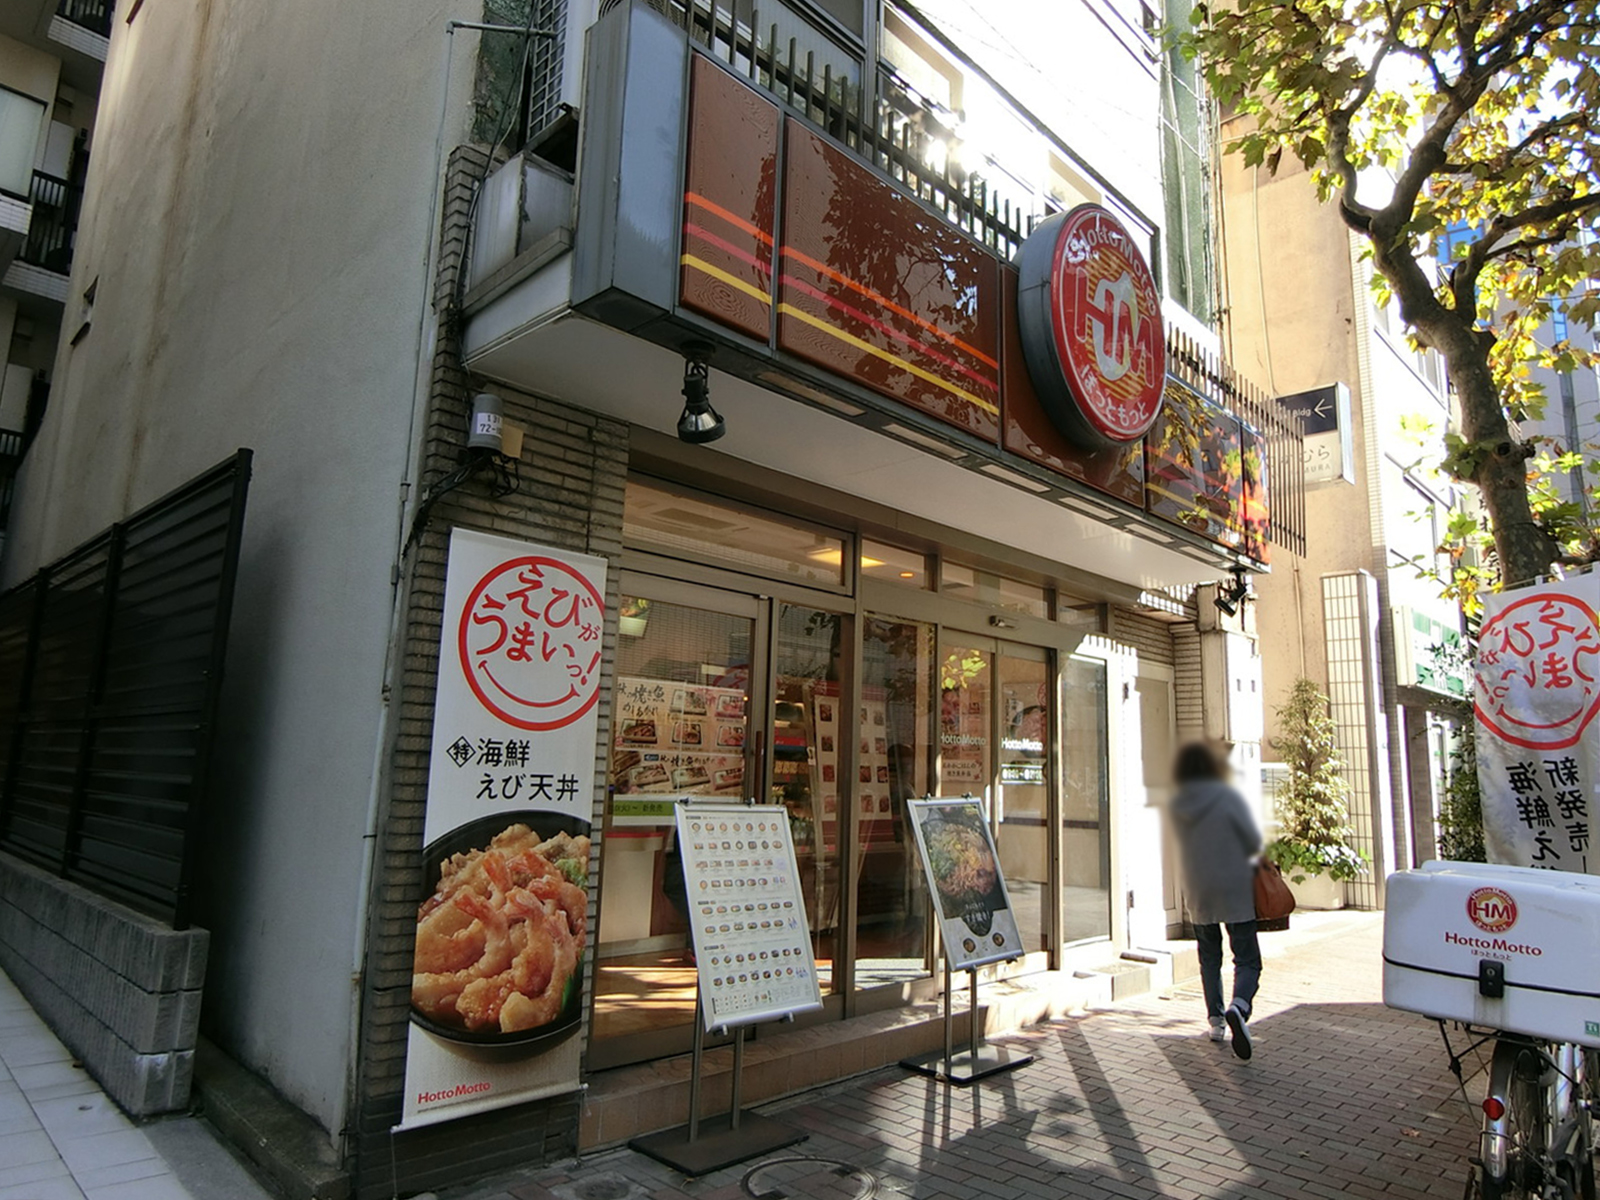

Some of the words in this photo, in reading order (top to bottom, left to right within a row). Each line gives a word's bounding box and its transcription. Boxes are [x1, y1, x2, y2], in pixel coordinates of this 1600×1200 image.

[1074, 266, 1154, 388] HM
[1079, 363, 1149, 427] ほっともっと
[476, 737, 531, 768] 海鮮
[1472, 901, 1512, 921] HM
[1445, 931, 1542, 957] HottoMotto
[1471, 949, 1512, 961] ほっともっと
[417, 1082, 491, 1104] HottoMotto
